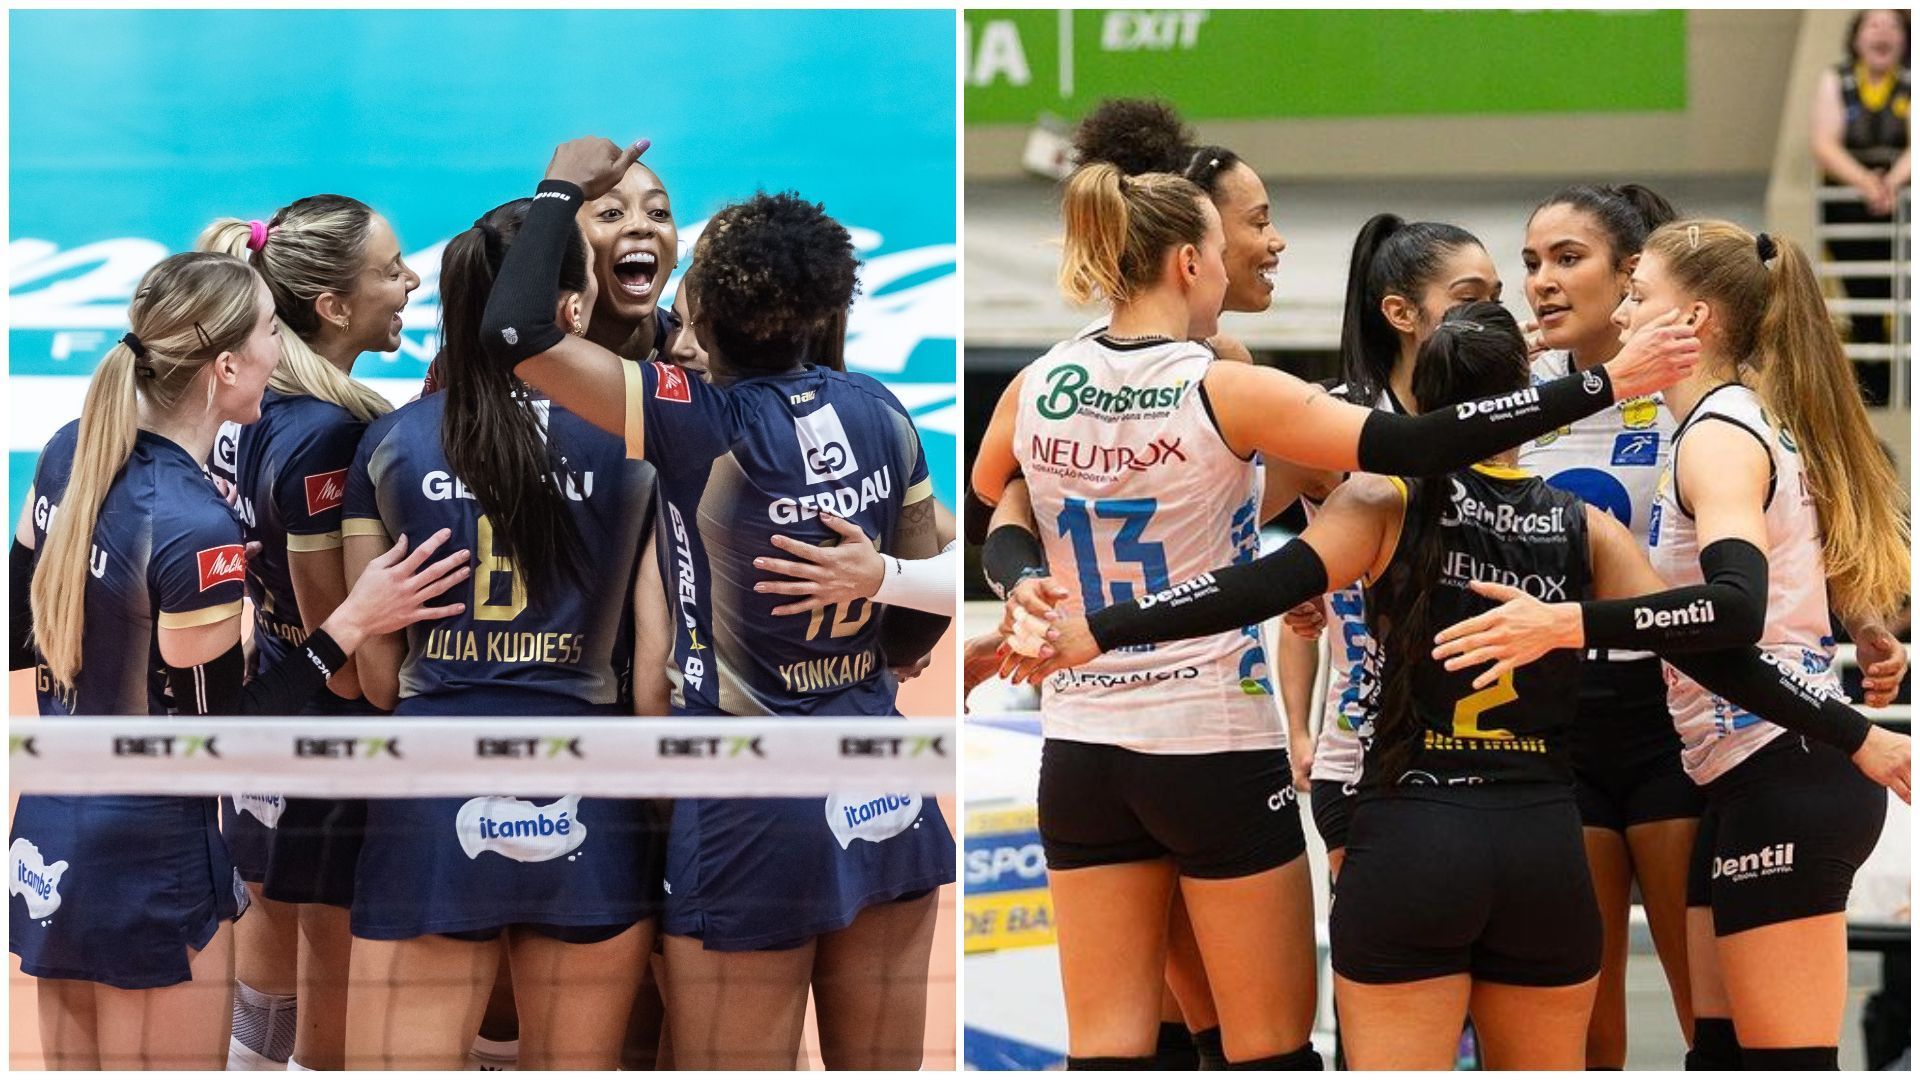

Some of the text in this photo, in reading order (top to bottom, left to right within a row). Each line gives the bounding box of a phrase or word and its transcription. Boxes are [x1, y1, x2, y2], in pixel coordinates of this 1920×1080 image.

[1100, 9, 1209, 51] EXIT
[1455, 386, 1540, 420] Dentil
[768, 465, 892, 526] GERDAU
[668, 501, 696, 629] ESTRELA
[1057, 497, 1172, 616] 13
[1634, 599, 1715, 631] Dentil
[486, 631, 585, 664] KUDIESS
[479, 812, 571, 840] itambé
[17, 858, 53, 901] itambé
